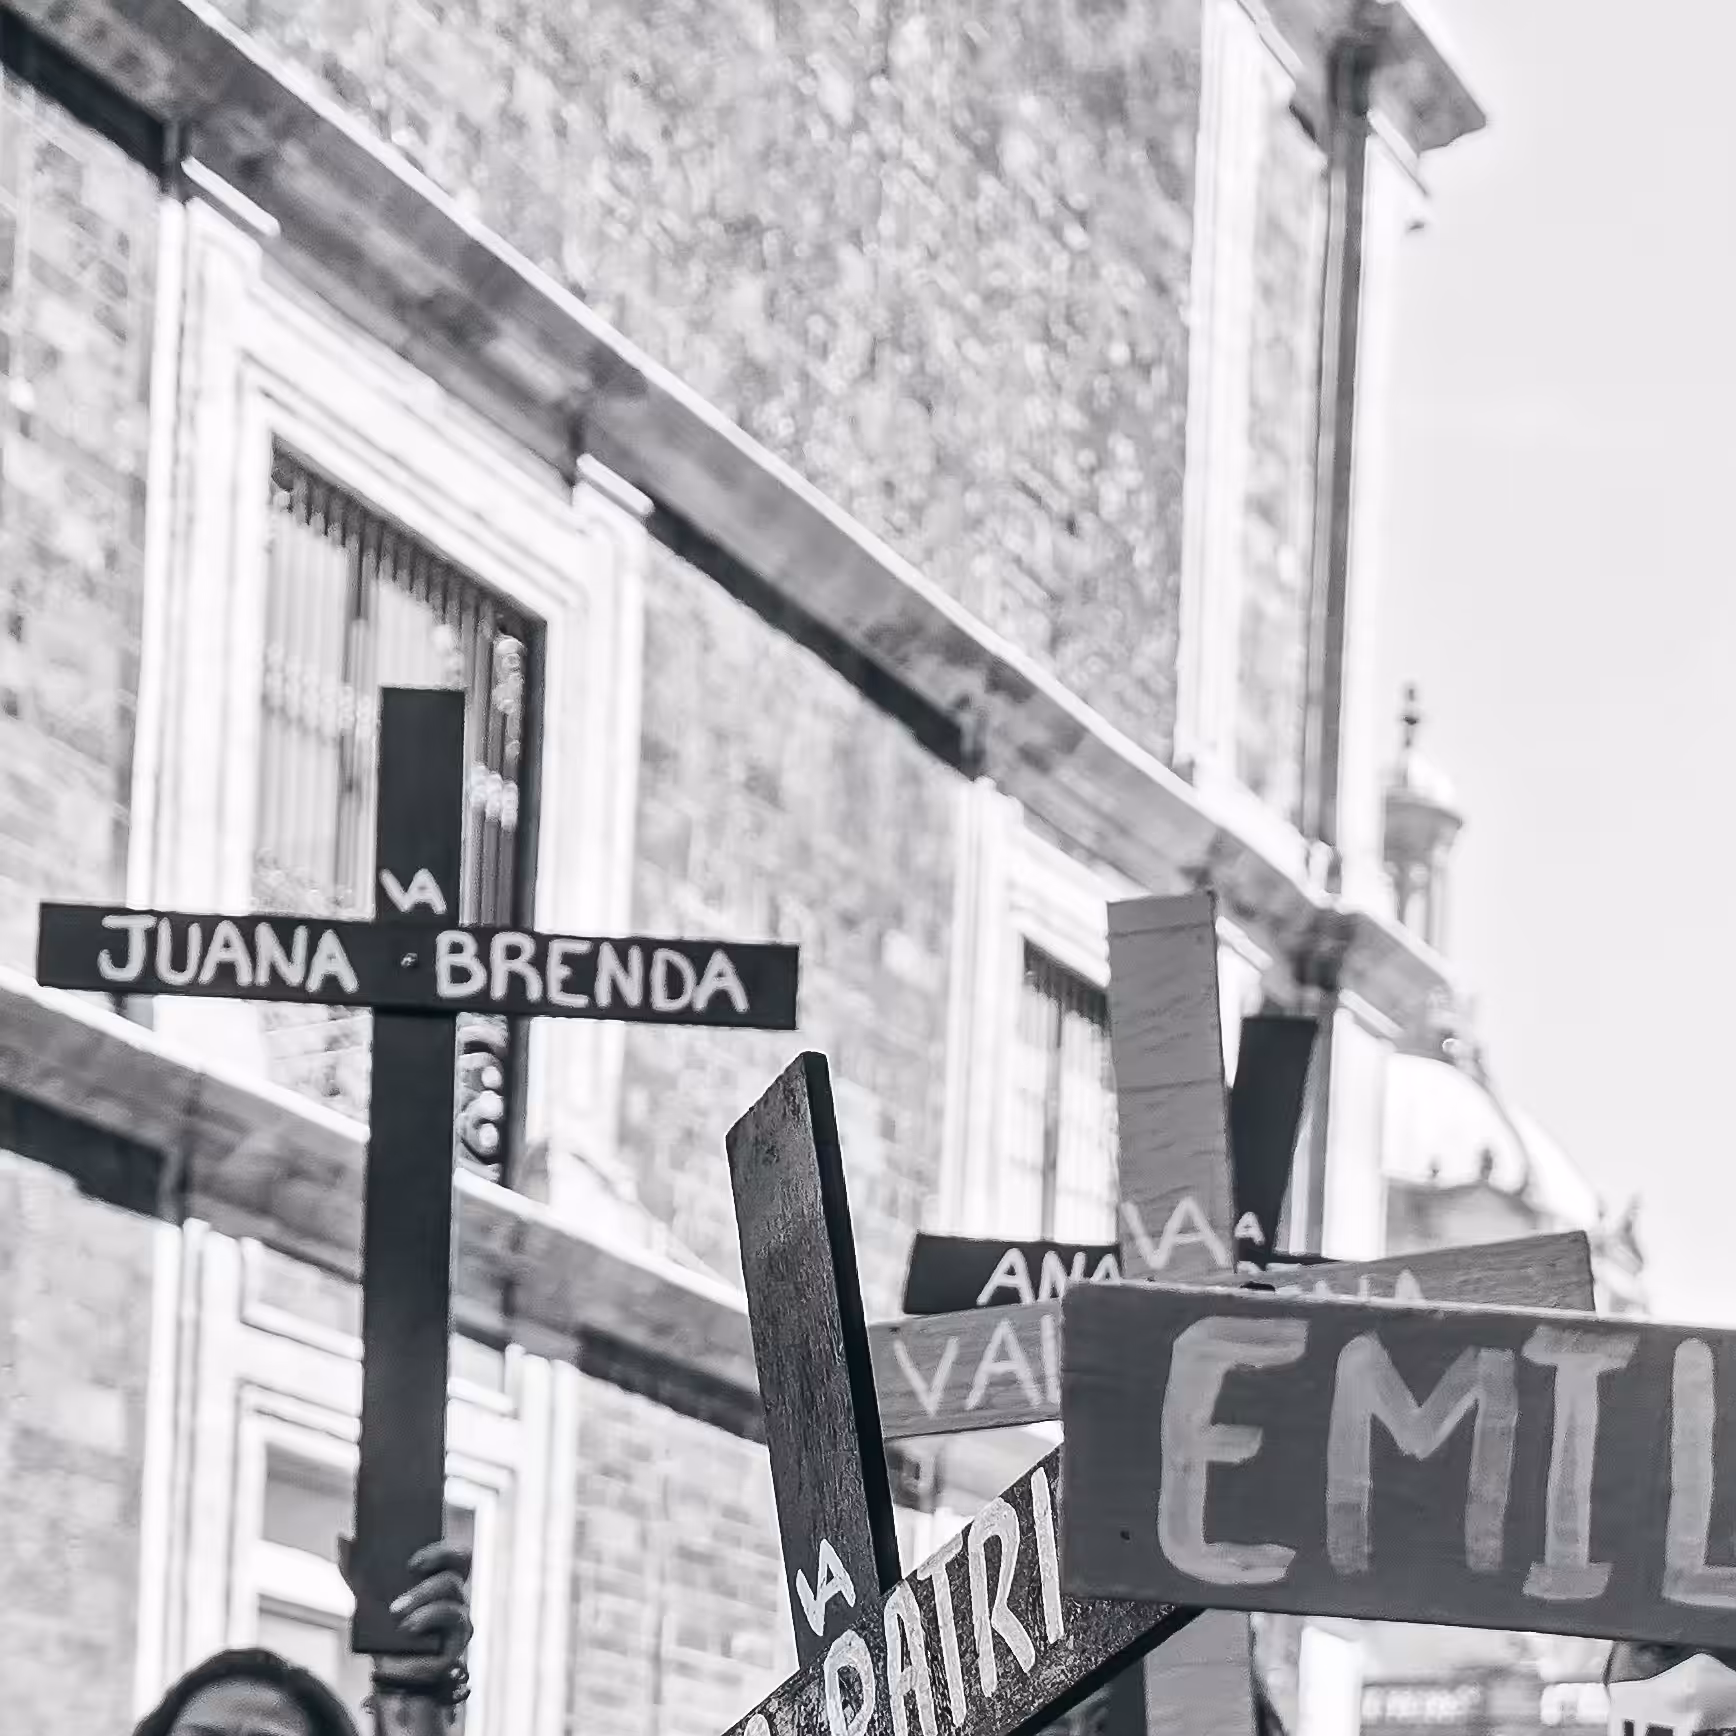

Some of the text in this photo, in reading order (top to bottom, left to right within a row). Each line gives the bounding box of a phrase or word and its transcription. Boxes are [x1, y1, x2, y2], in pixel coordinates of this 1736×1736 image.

[378, 867, 448, 915] VA
[97, 914, 748, 1013] JUANA BRENDA
